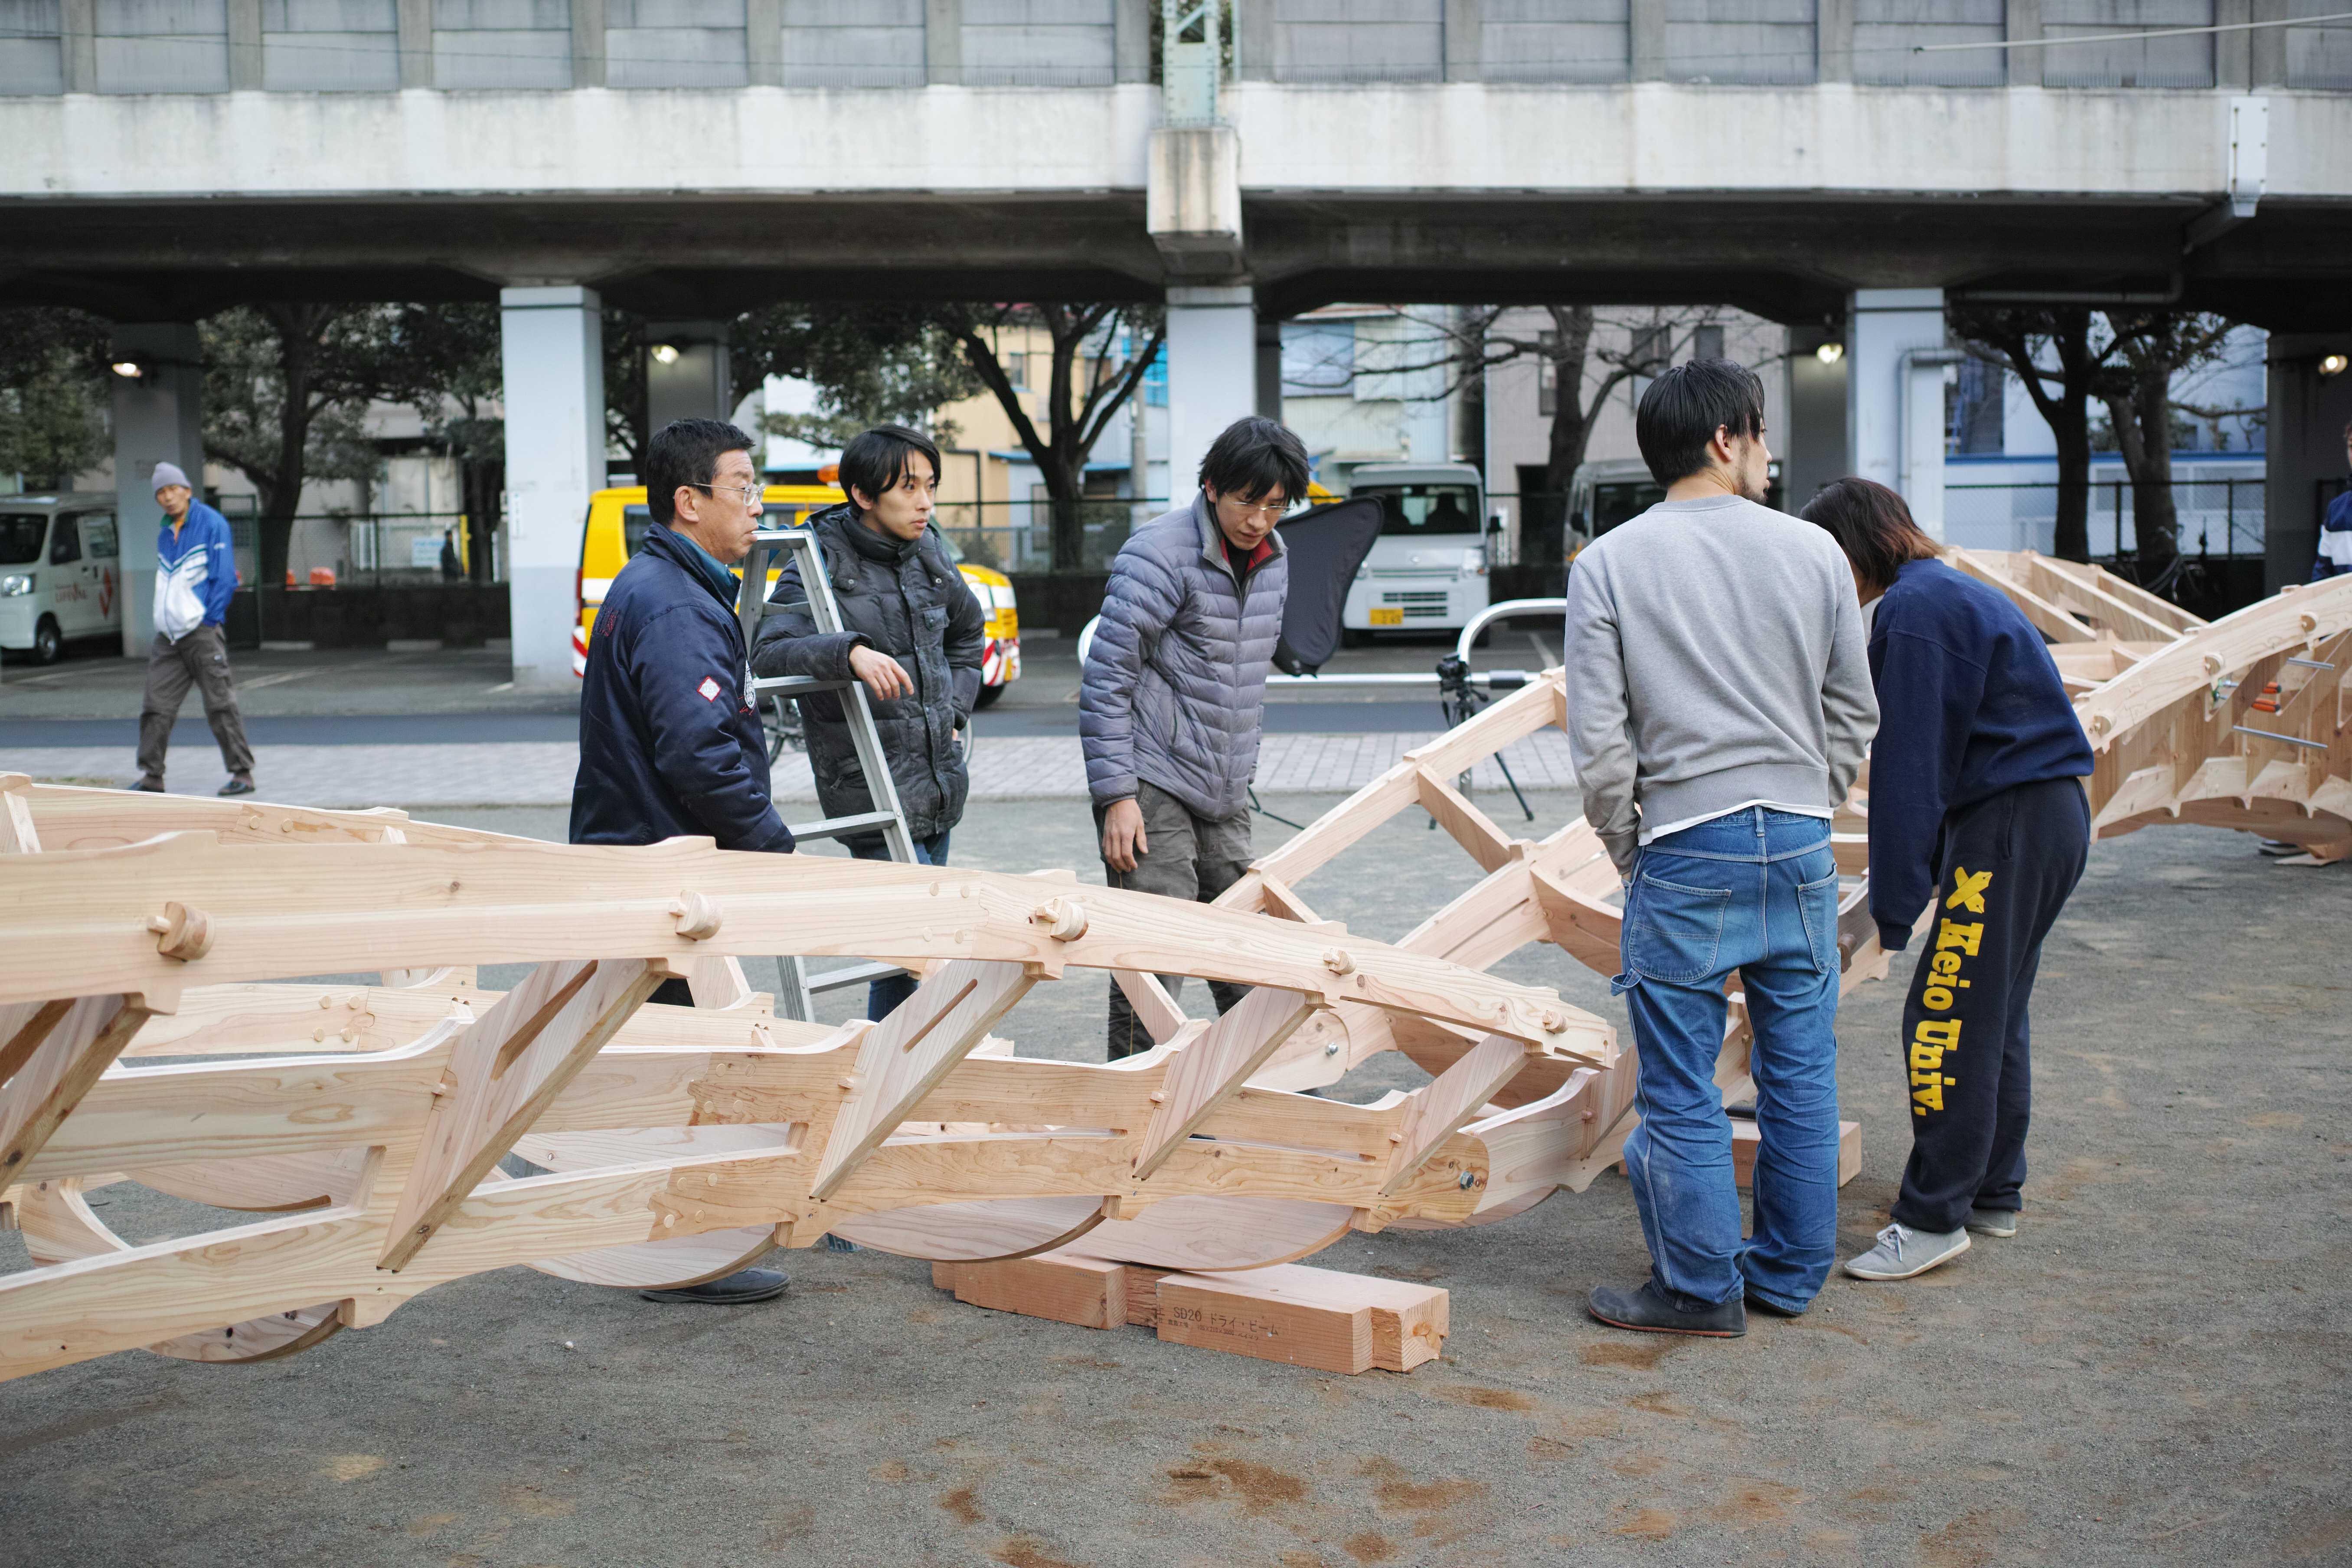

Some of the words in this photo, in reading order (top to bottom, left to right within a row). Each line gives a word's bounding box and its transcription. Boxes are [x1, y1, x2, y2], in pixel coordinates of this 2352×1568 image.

[1923, 918, 1985, 1011] Keio
[1910, 1019, 1963, 1117] Univ.
[1173, 1307, 1202, 1322] SD20
[1210, 1313, 1279, 1336] ドライ・ビーム
